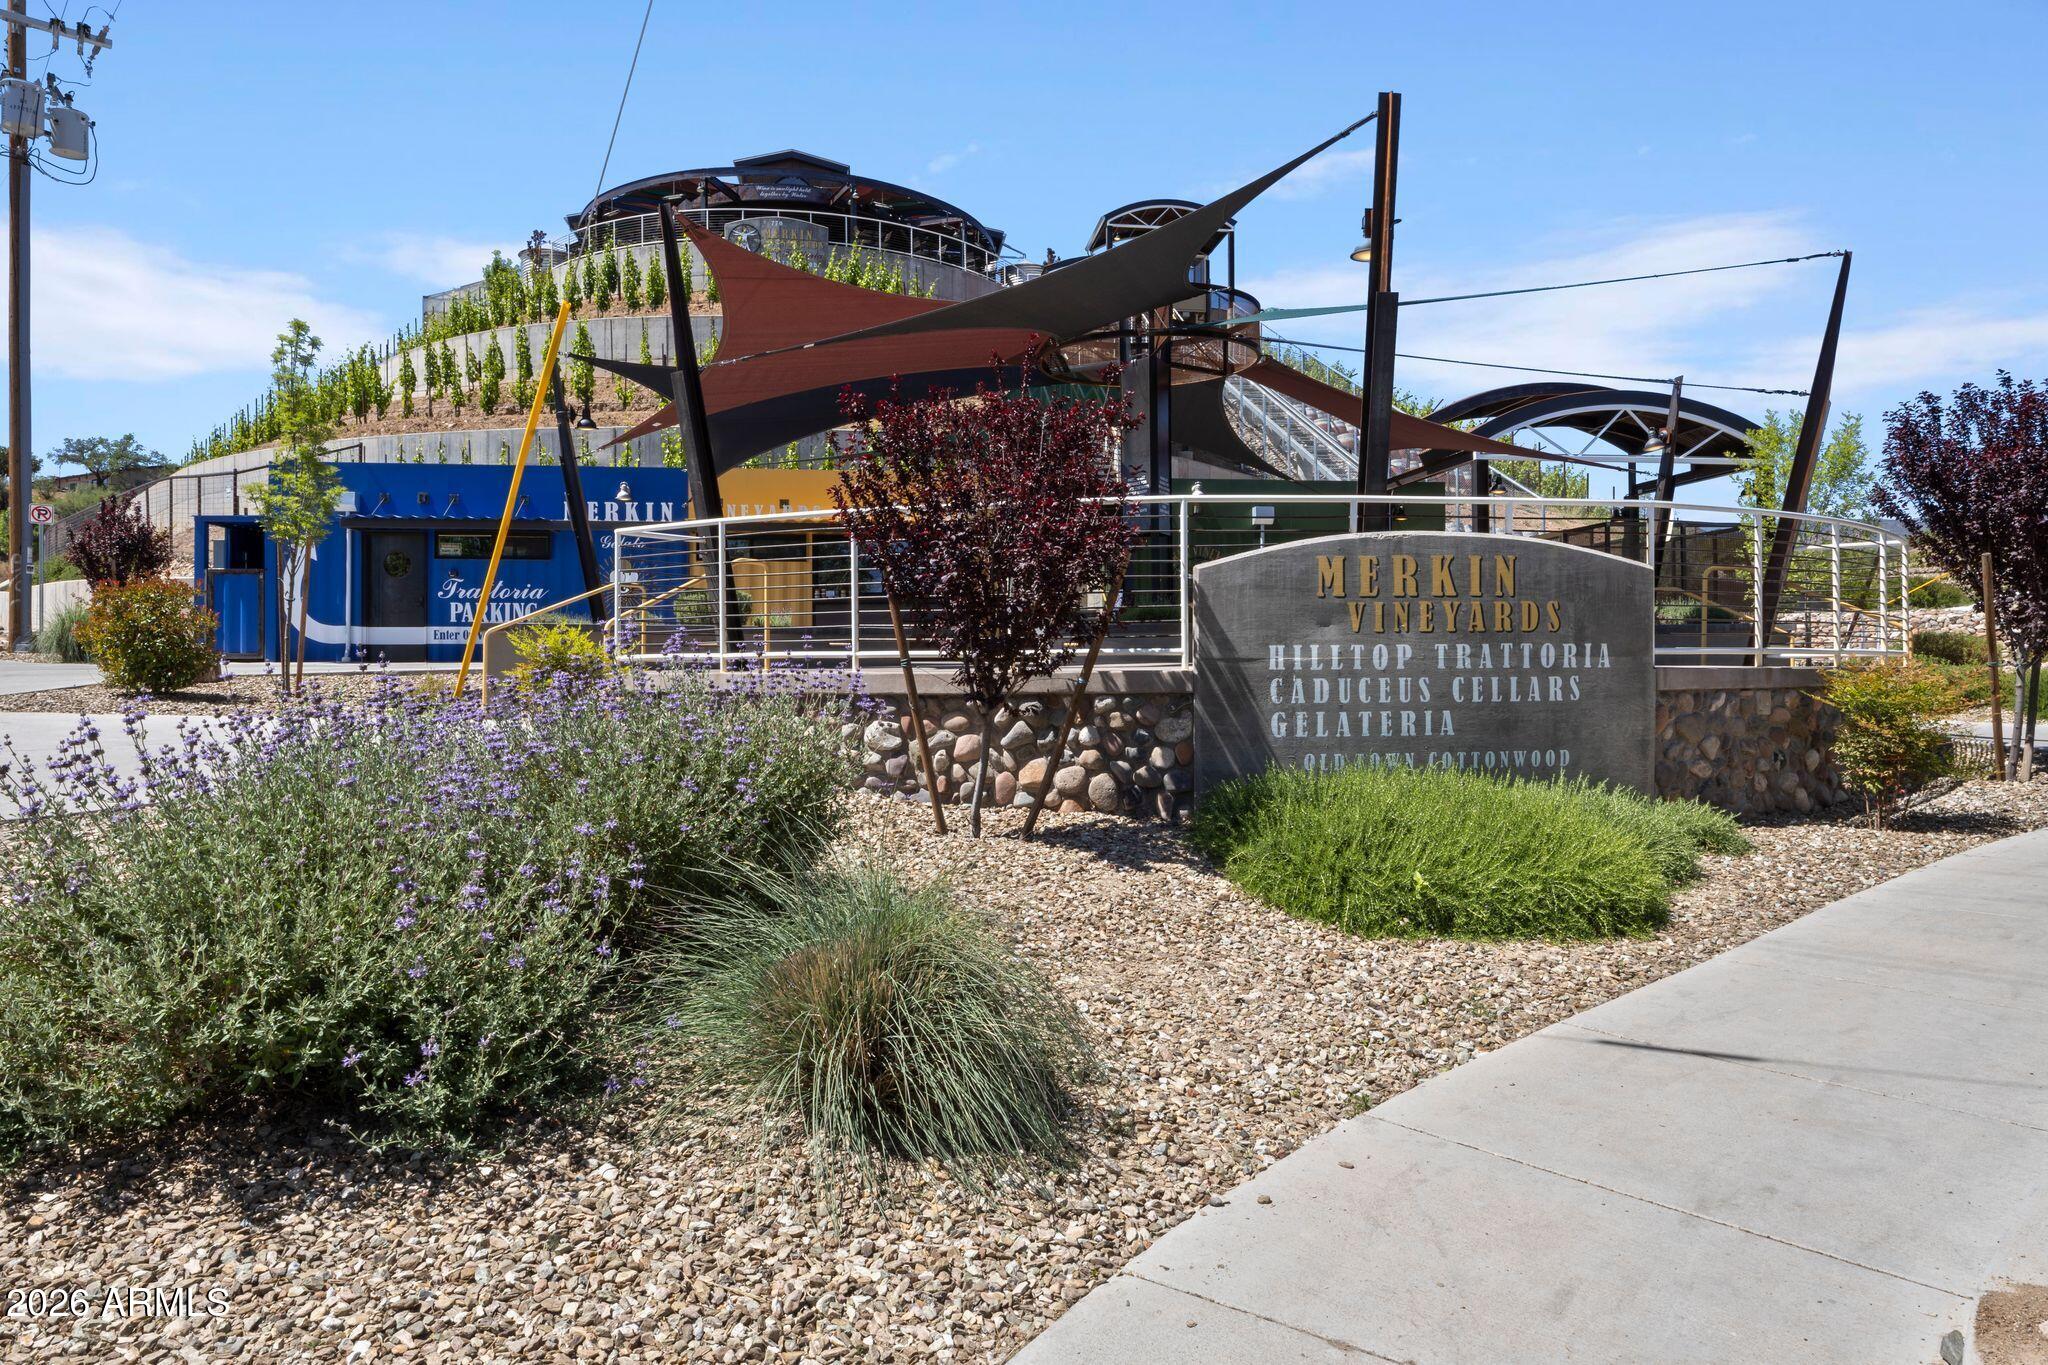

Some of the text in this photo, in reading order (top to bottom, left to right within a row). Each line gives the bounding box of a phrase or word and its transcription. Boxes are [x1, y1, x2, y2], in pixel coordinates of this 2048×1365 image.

[437, 577, 550, 600] Tratoria
[1316, 554, 1518, 599] MERKIN
[1347, 599, 1562, 634] VINEYARDS
[433, 629, 460, 641] Enter
[1268, 642, 1612, 671] HILLTOP TRATTORIA
[1269, 675, 1581, 704] CADUCEUS CELLARS
[1270, 710, 1456, 739] GELATERIA
[1303, 750, 1571, 771] OLD TOWN COTTONWOOD
